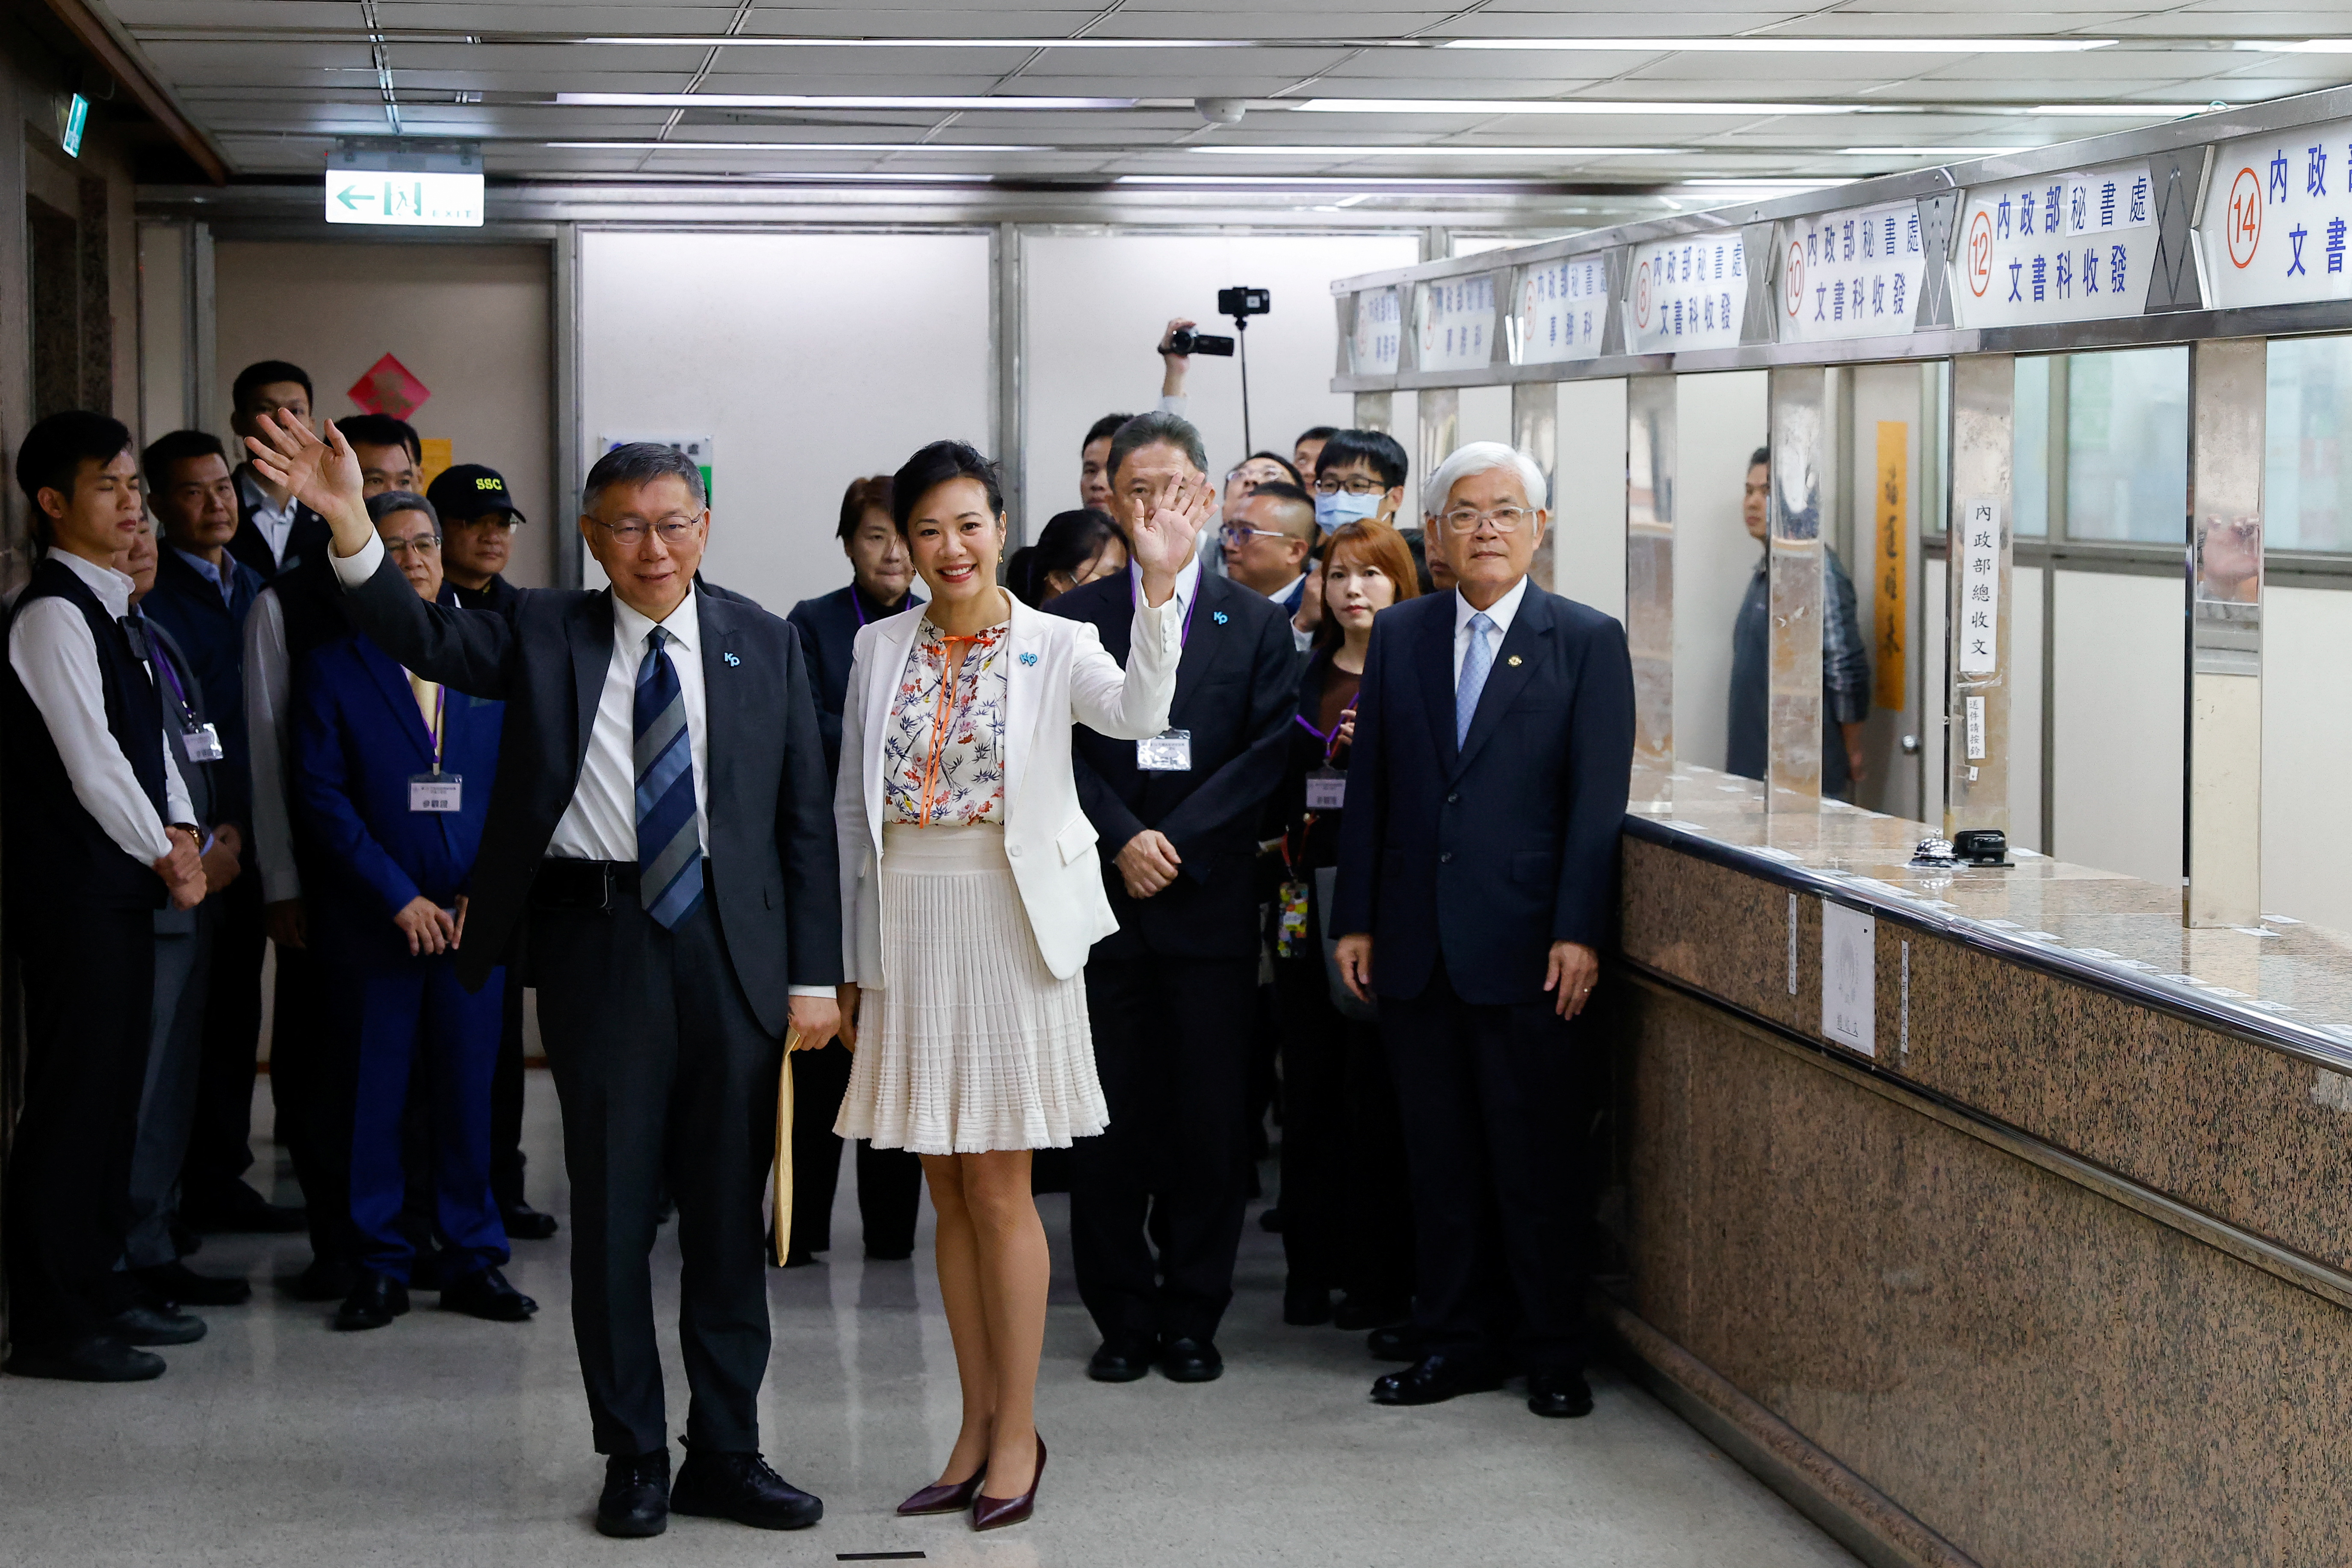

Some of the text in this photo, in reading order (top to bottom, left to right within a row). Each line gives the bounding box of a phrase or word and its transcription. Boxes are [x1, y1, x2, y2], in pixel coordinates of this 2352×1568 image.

[1997, 176, 2148, 240] 內政部秘書處
[1653, 242, 1743, 287] 內政部秘書處
[1808, 213, 1919, 267] 內政部秘書處
[2287, 217, 2347, 278] 文書
[1814, 273, 1906, 322] 文書科收發
[2008, 243, 2127, 303] 文書科收發
[1660, 292, 1731, 335] 文書科收發
[476, 478, 502, 490] SSC
[1971, 505, 1992, 656] 內政部總收文
